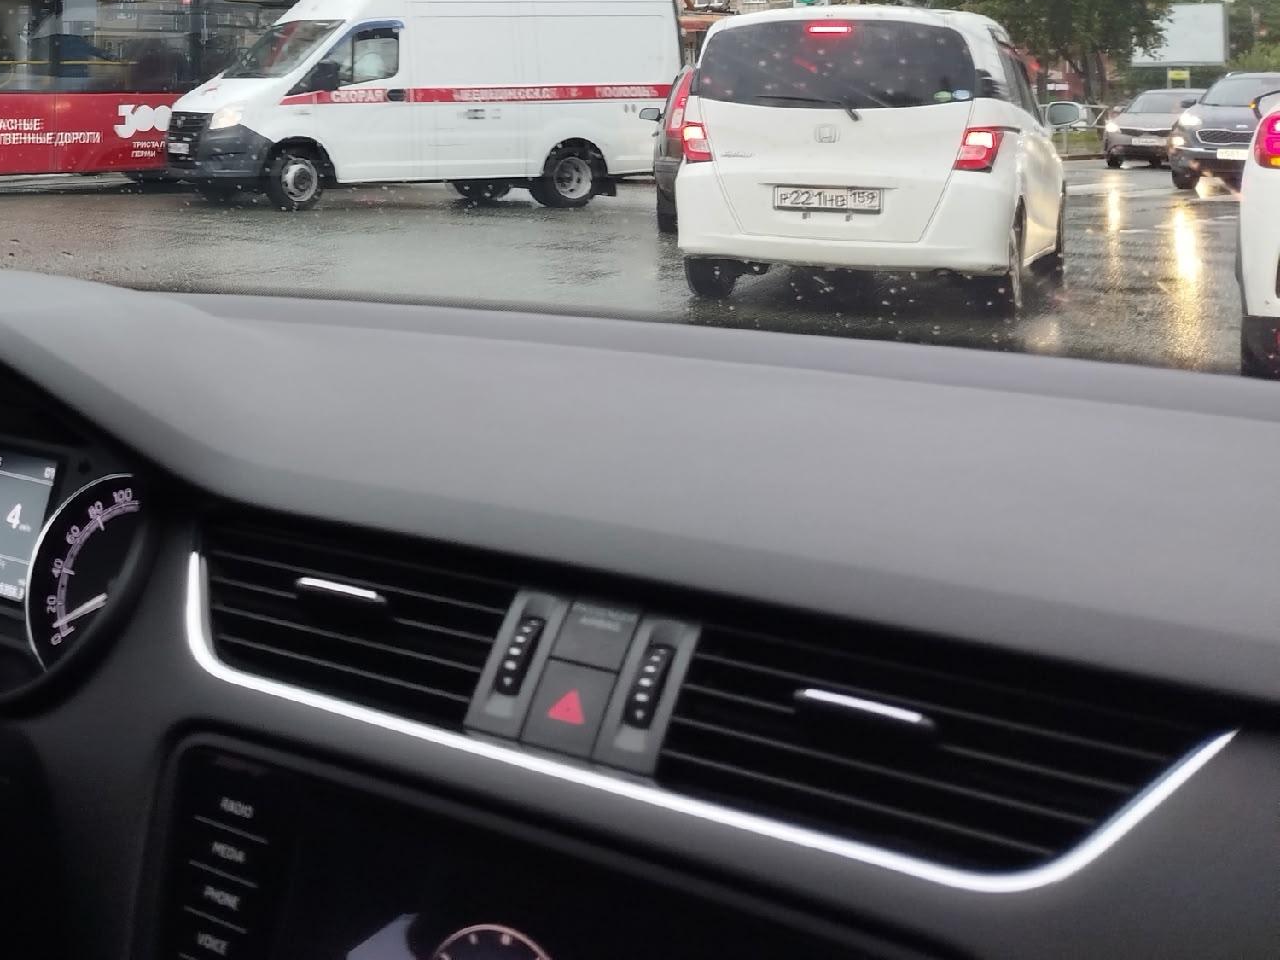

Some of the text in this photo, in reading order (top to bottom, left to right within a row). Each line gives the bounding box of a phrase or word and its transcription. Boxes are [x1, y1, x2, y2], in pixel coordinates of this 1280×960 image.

[113, 104, 172, 138] 300
[54, 131, 102, 147] ДОРОГИ
[112, 488, 133, 504] 100
[6, 503, 22, 529] 4
